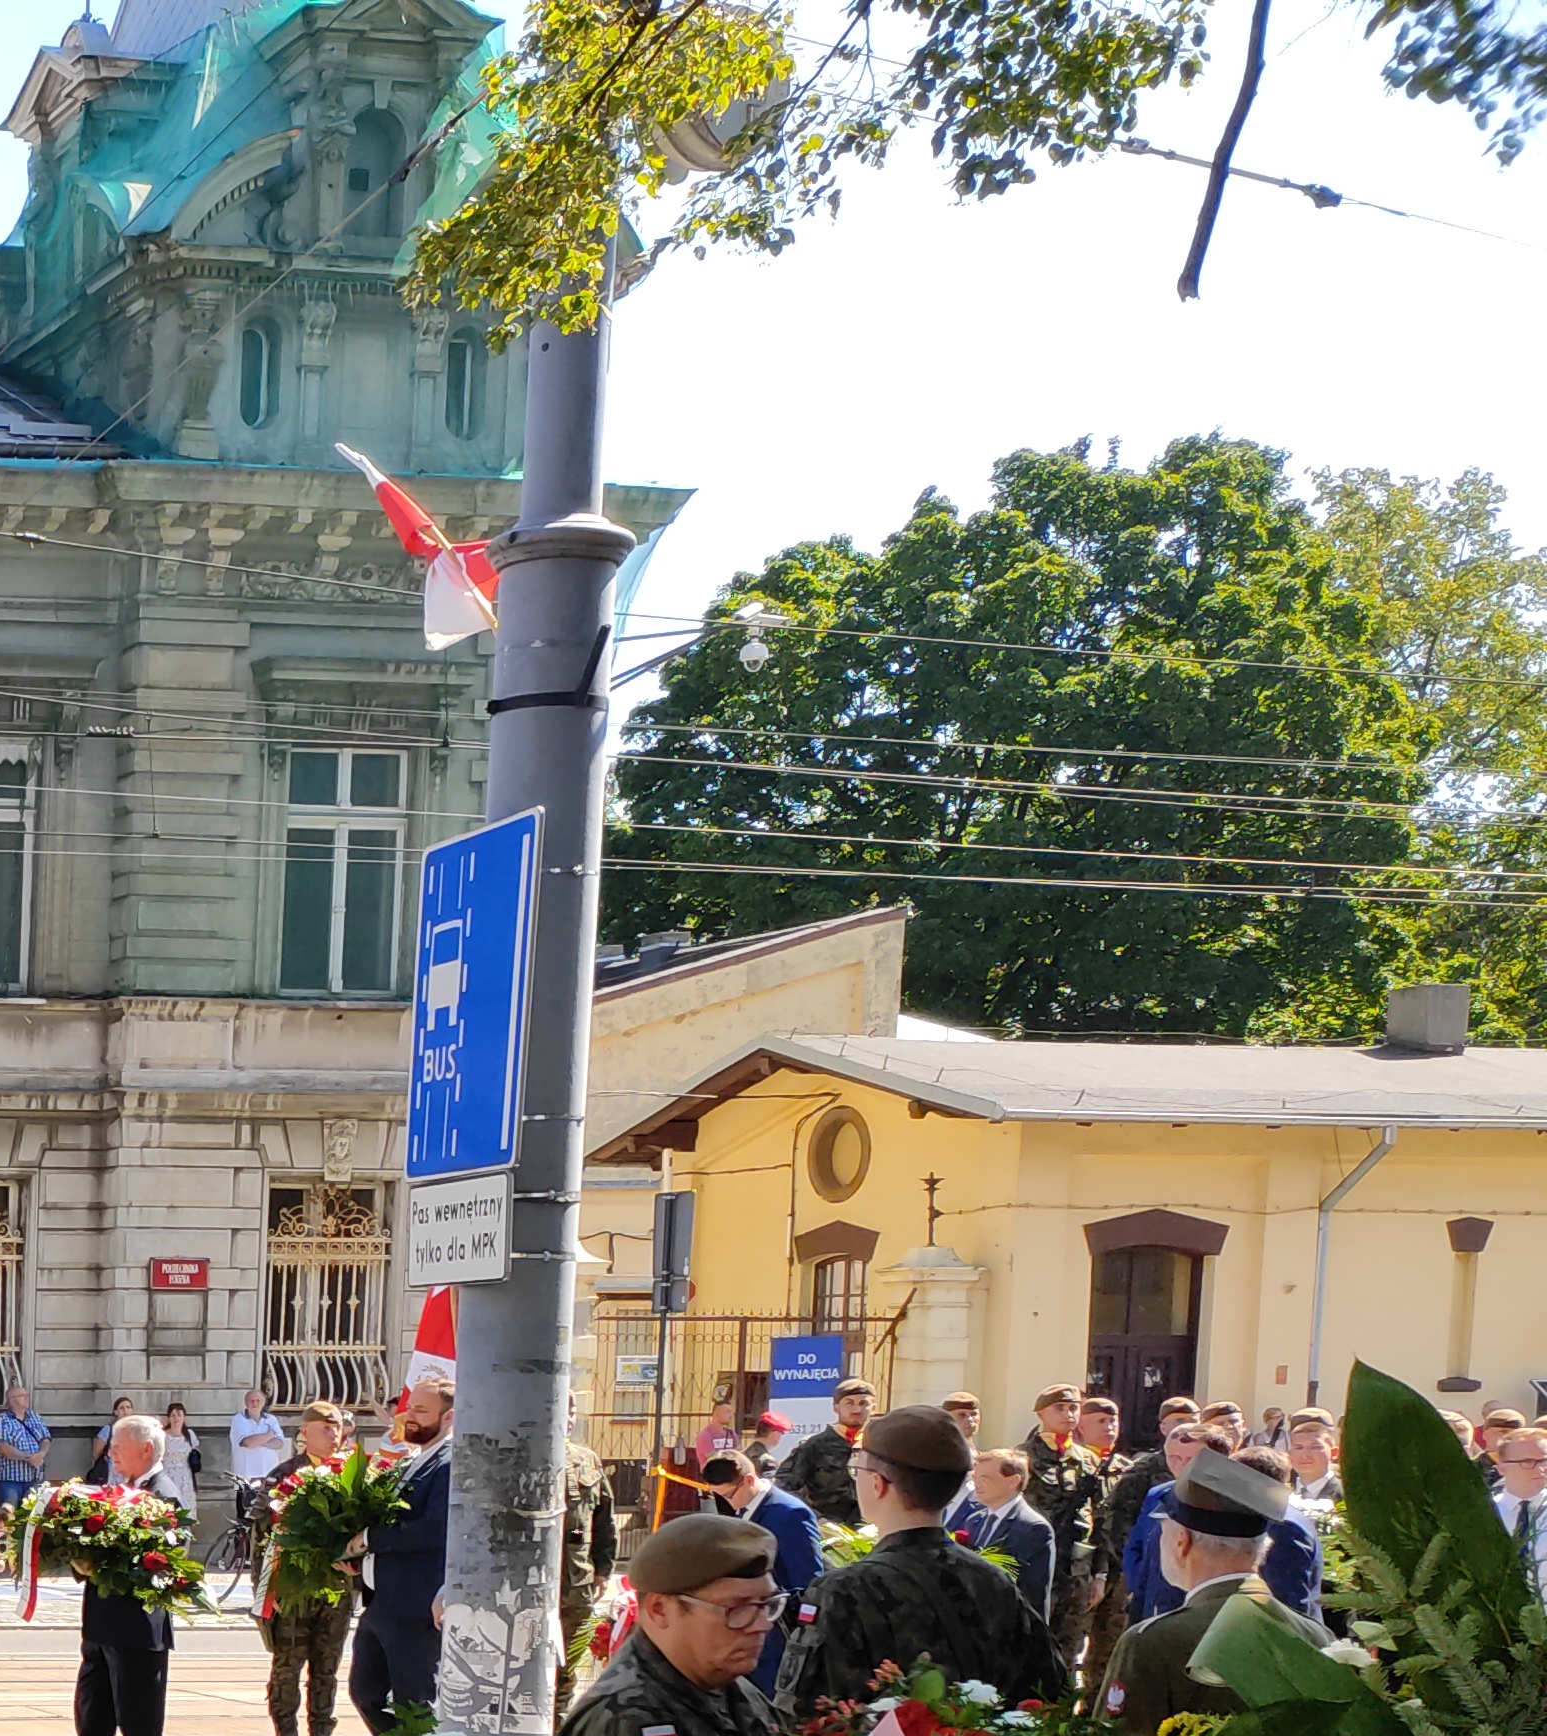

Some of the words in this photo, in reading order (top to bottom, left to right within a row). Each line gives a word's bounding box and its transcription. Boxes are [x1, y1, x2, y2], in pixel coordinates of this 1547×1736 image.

[422, 1043, 458, 1084] BUS
[412, 1200, 430, 1226] Pas
[434, 1193, 504, 1226] wewnętrzny
[415, 1239, 442, 1273] tylko
[447, 1236, 466, 1262] dla
[471, 1231, 498, 1259] MPK
[773, 1368, 840, 1382] WYNAJĘCIA
[797, 1353, 817, 1365] DO
